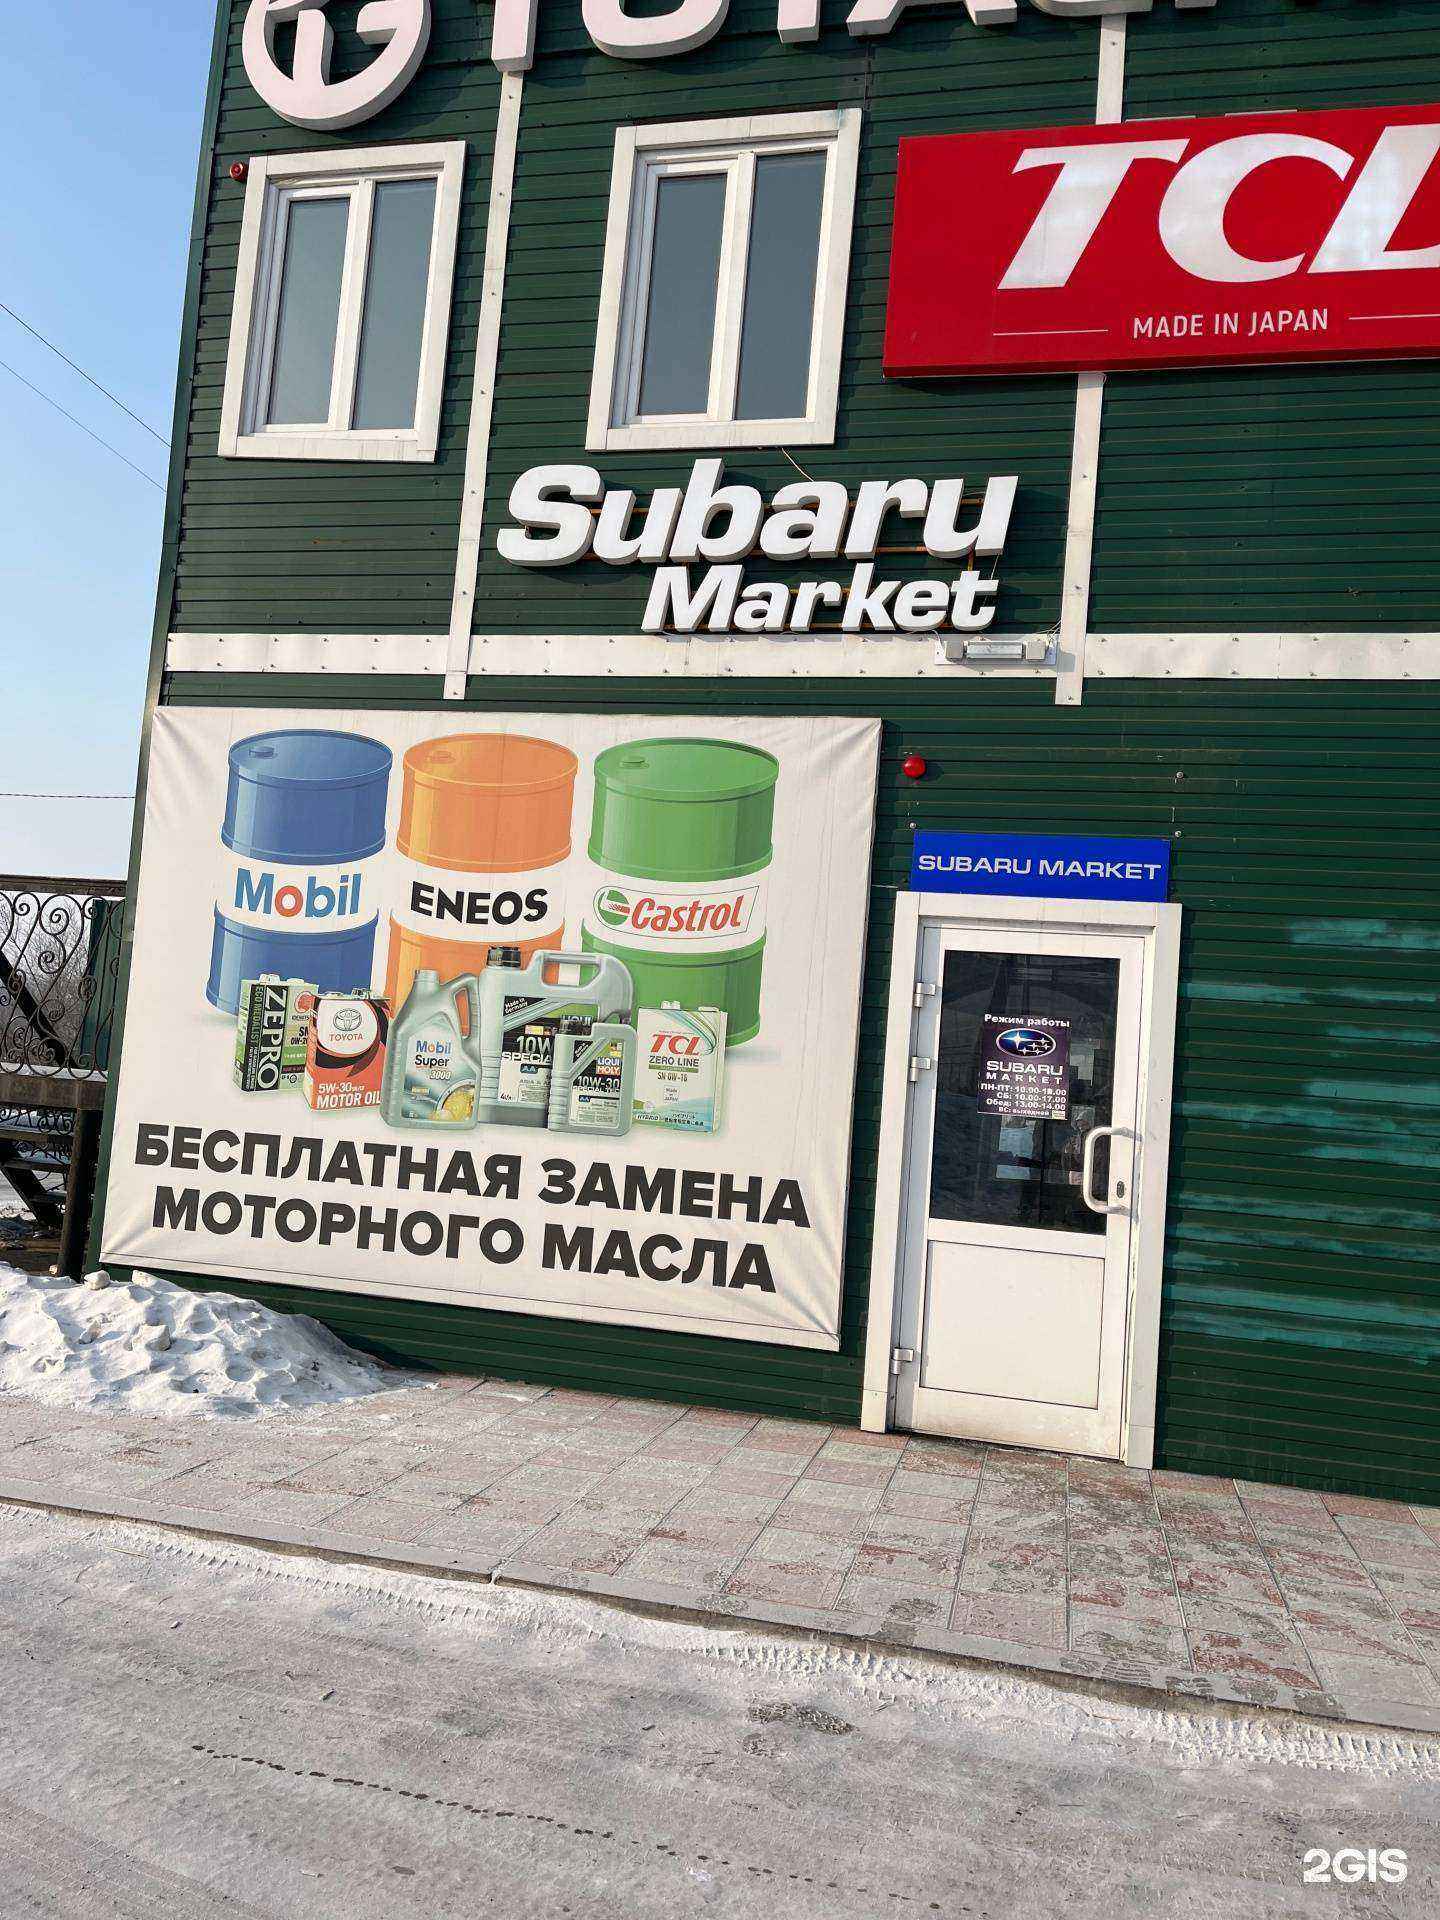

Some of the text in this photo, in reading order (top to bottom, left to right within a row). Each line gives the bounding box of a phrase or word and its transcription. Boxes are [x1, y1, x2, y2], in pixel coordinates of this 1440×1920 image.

[998, 123, 1440, 289] TCL
[1133, 308, 1328, 339] MADE IN JAPAN
[497, 458, 1019, 566] Subaru
[641, 563, 999, 633] Market
[918, 855, 1162, 880] SUBARU MARKET
[235, 868, 362, 918] Mobil
[410, 881, 548, 925] ENEOS
[631, 895, 744, 932] Castrol
[984, 1013, 1070, 1028] Режим работы
[258, 986, 288, 1089] ZEPRO
[329, 1033, 364, 1041] TOYOTA
[516, 1036, 553, 1054] 10W
[650, 1034, 701, 1056] TCL
[415, 1040, 452, 1055] Mobil
[414, 1055, 450, 1068] Super
[597, 1058, 620, 1066] LIQUI
[649, 1055, 700, 1067] ZERO LINE
[986, 1060, 1064, 1076] SUBARU
[430, 1070, 452, 1080] 3000
[597, 1066, 621, 1075] MOLY
[985, 1072, 1063, 1085] MARKET
[318, 1082, 352, 1095] 5W-30
[577, 1076, 620, 1089] 10W-30
[316, 1090, 381, 1109] MOTOR OIL
[986, 1098, 1066, 1111] Обед: 13.00-14.00
[996, 1091, 1067, 1103] СБ: 10.00-17.00
[1012, 1108, 1050, 1116] выходной
[134, 1123, 810, 1228] БЕСПЛАТНАЯ ЗАМЕНА
[152, 1186, 777, 1293] МОТОРНОГО МАСЛА
